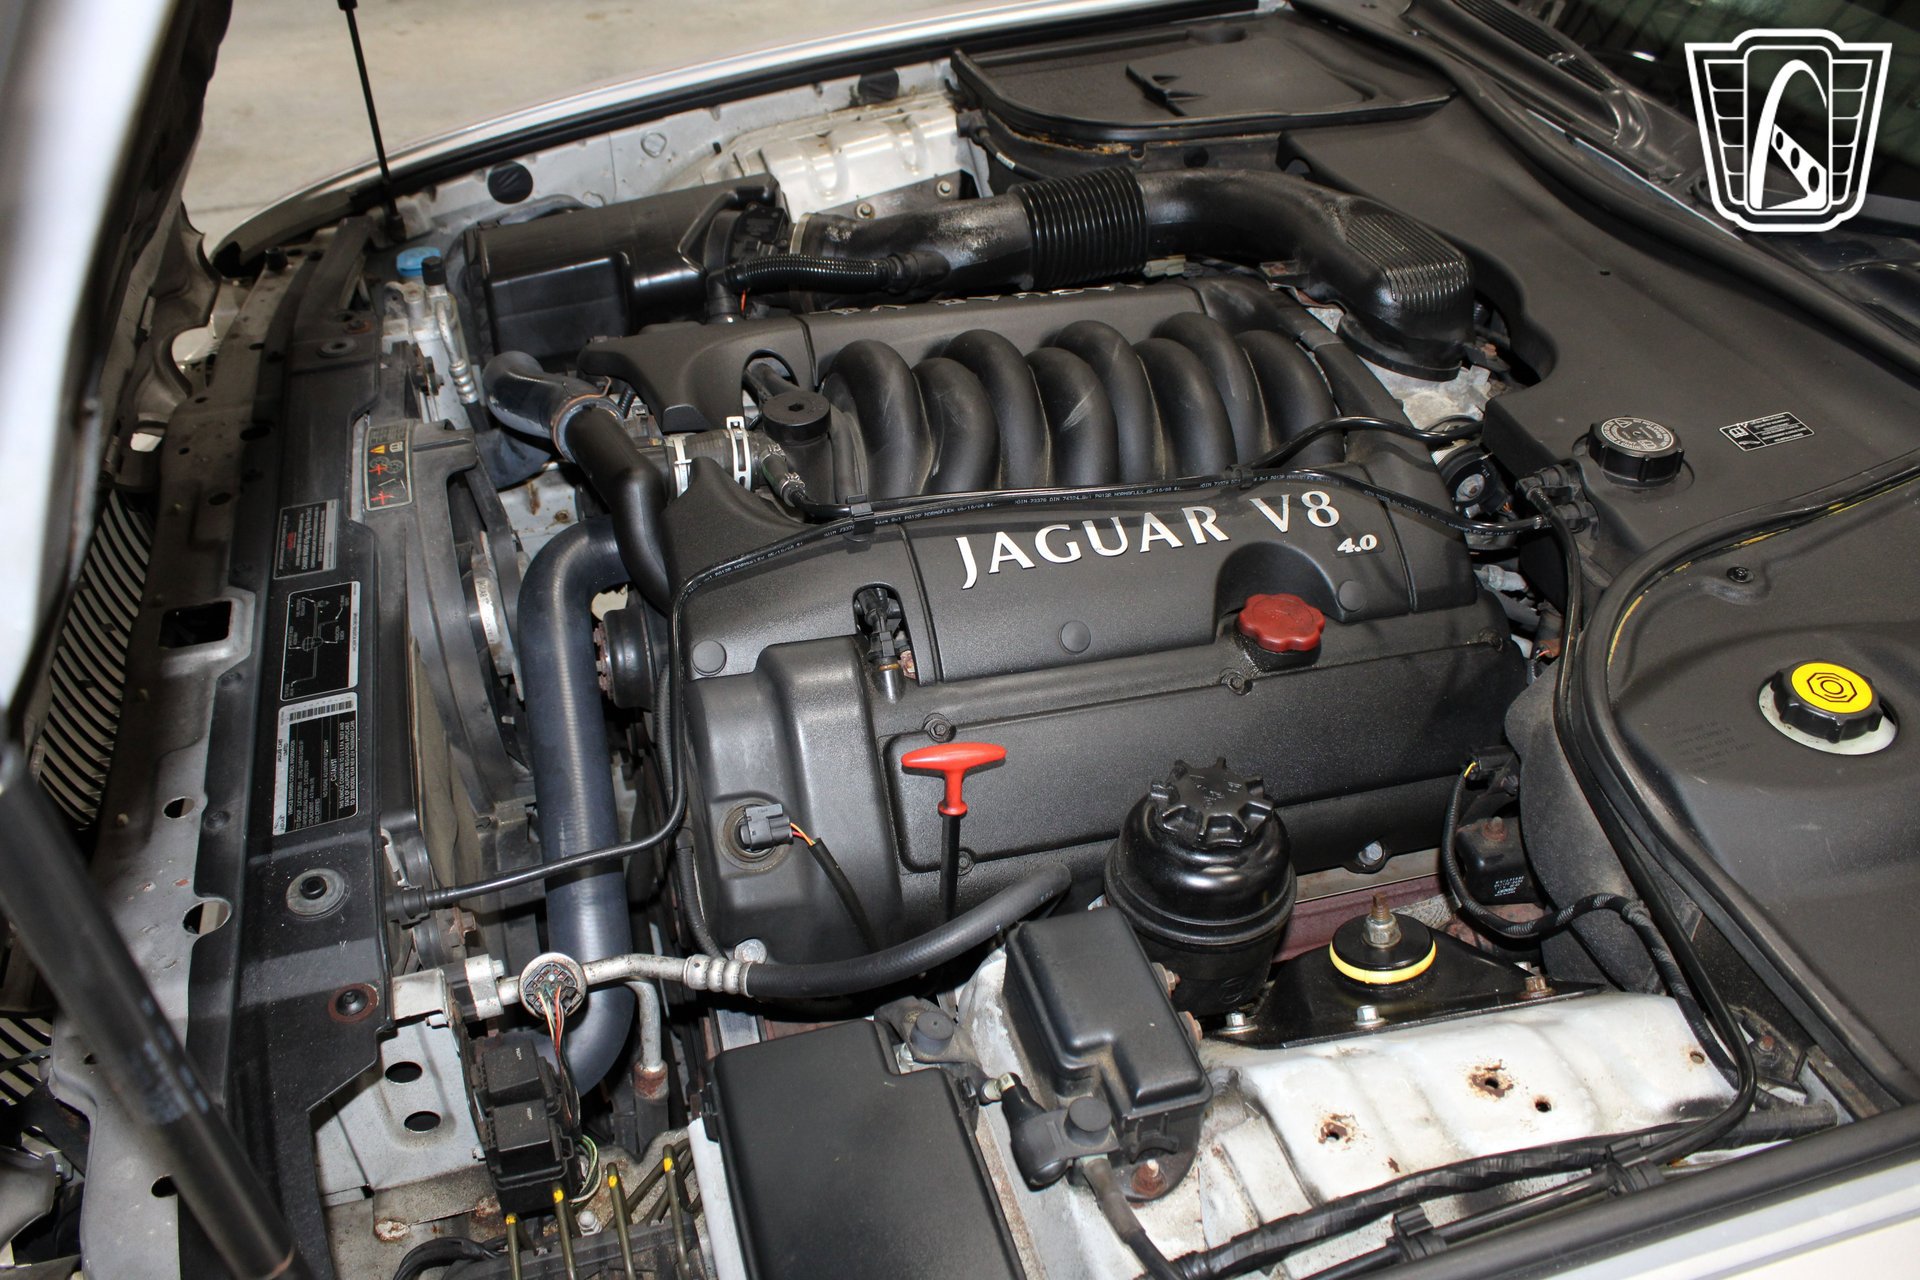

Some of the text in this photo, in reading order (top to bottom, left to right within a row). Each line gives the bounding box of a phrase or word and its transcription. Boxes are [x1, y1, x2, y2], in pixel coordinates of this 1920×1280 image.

[955, 490, 1340, 590] JAGUAR V8
[1337, 534, 1378, 553] 4.0
